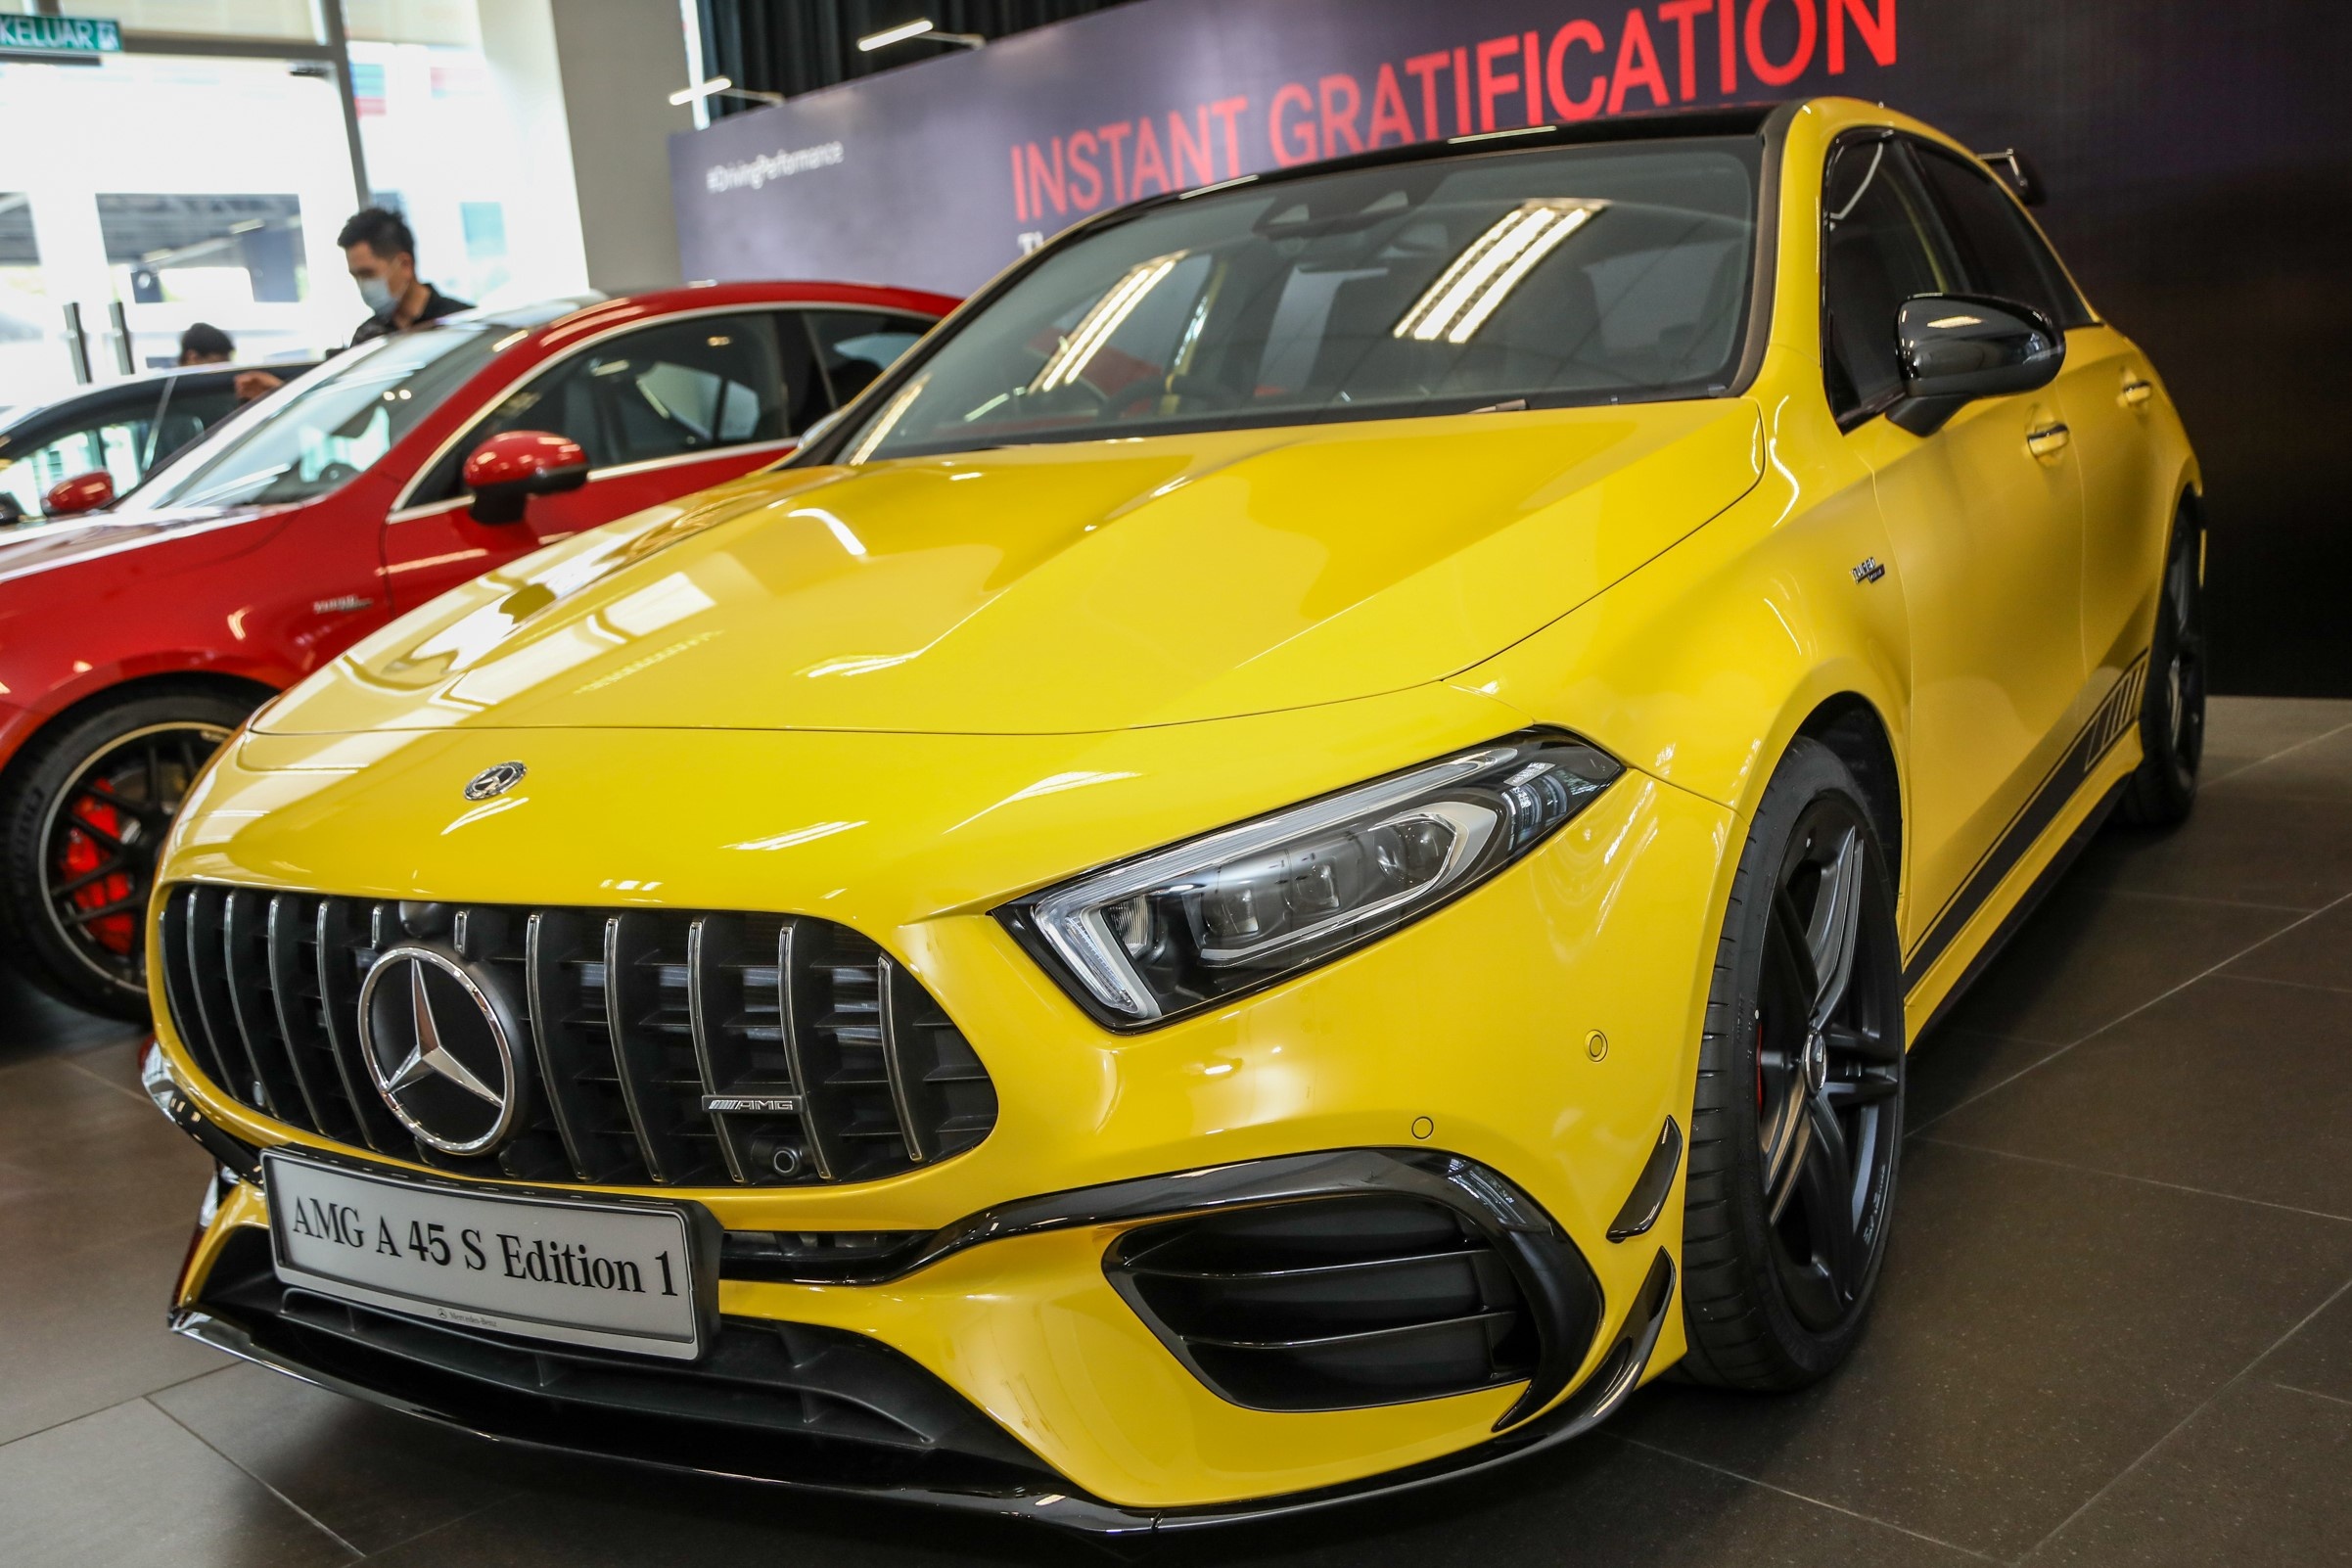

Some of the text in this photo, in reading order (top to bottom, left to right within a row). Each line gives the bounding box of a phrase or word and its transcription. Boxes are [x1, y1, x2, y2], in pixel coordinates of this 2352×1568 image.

[0, 18, 96, 50] KELUAR
[1011, 0, 1897, 224] INSTANT GRATIFICATION
[735, 1099, 794, 1111] AMG
[293, 1196, 678, 1297] AMG A 45 S Edition 1
